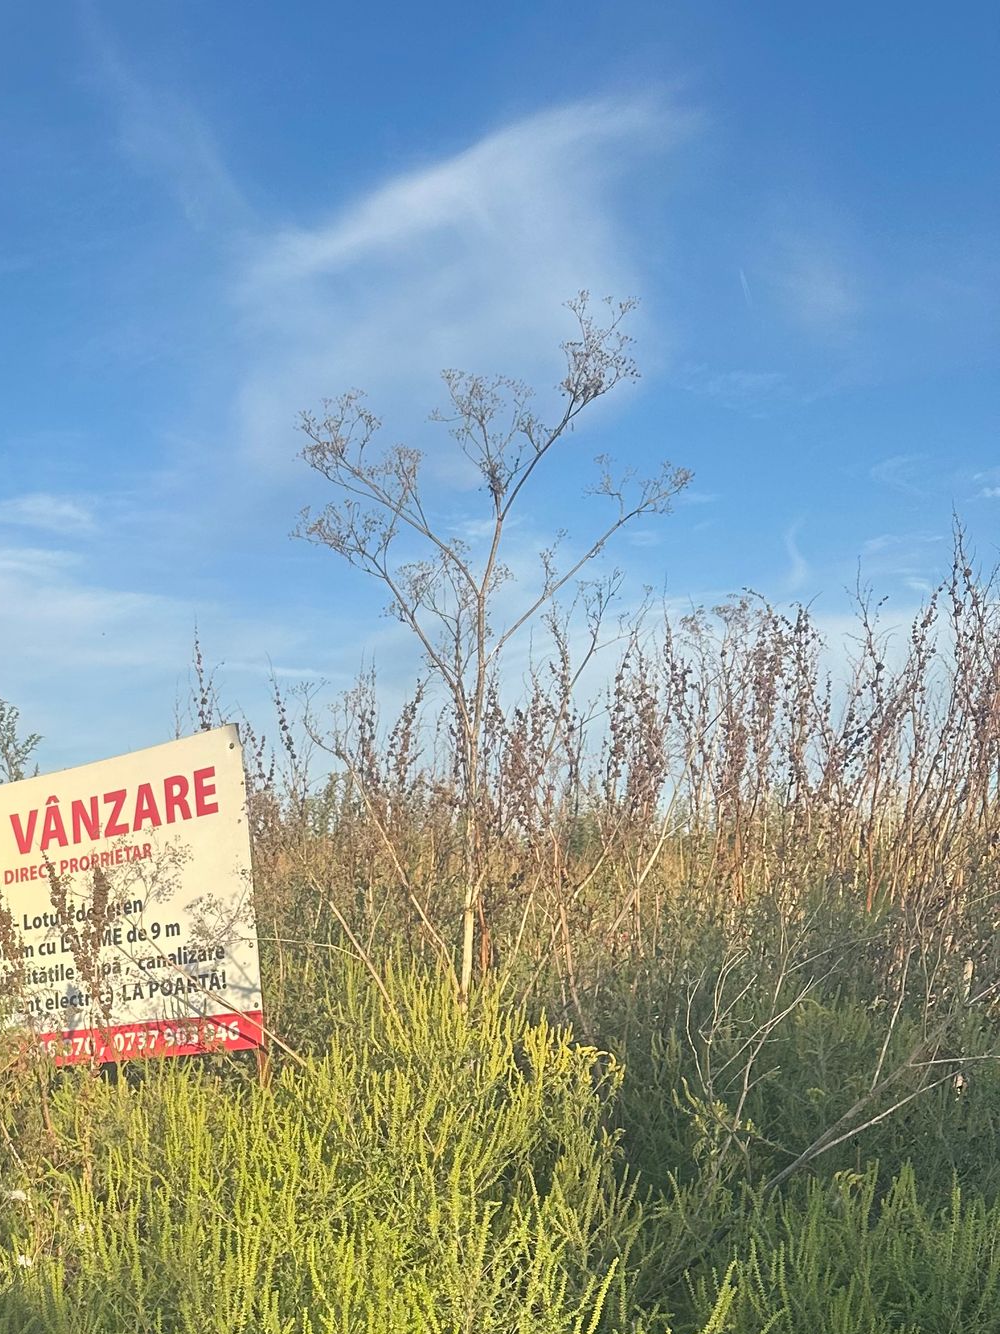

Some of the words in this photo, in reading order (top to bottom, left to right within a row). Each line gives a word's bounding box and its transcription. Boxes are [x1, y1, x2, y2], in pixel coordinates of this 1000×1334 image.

[9, 765, 220, 856] VÂNZARE
[60, 843, 153, 875] PROPRIETAR
[38, 942, 56, 956] cu
[126, 925, 148, 944] de
[151, 922, 161, 940] 9
[165, 922, 181, 937] m
[138, 945, 225, 971] canalizare
[122, 982, 144, 1001] LA
